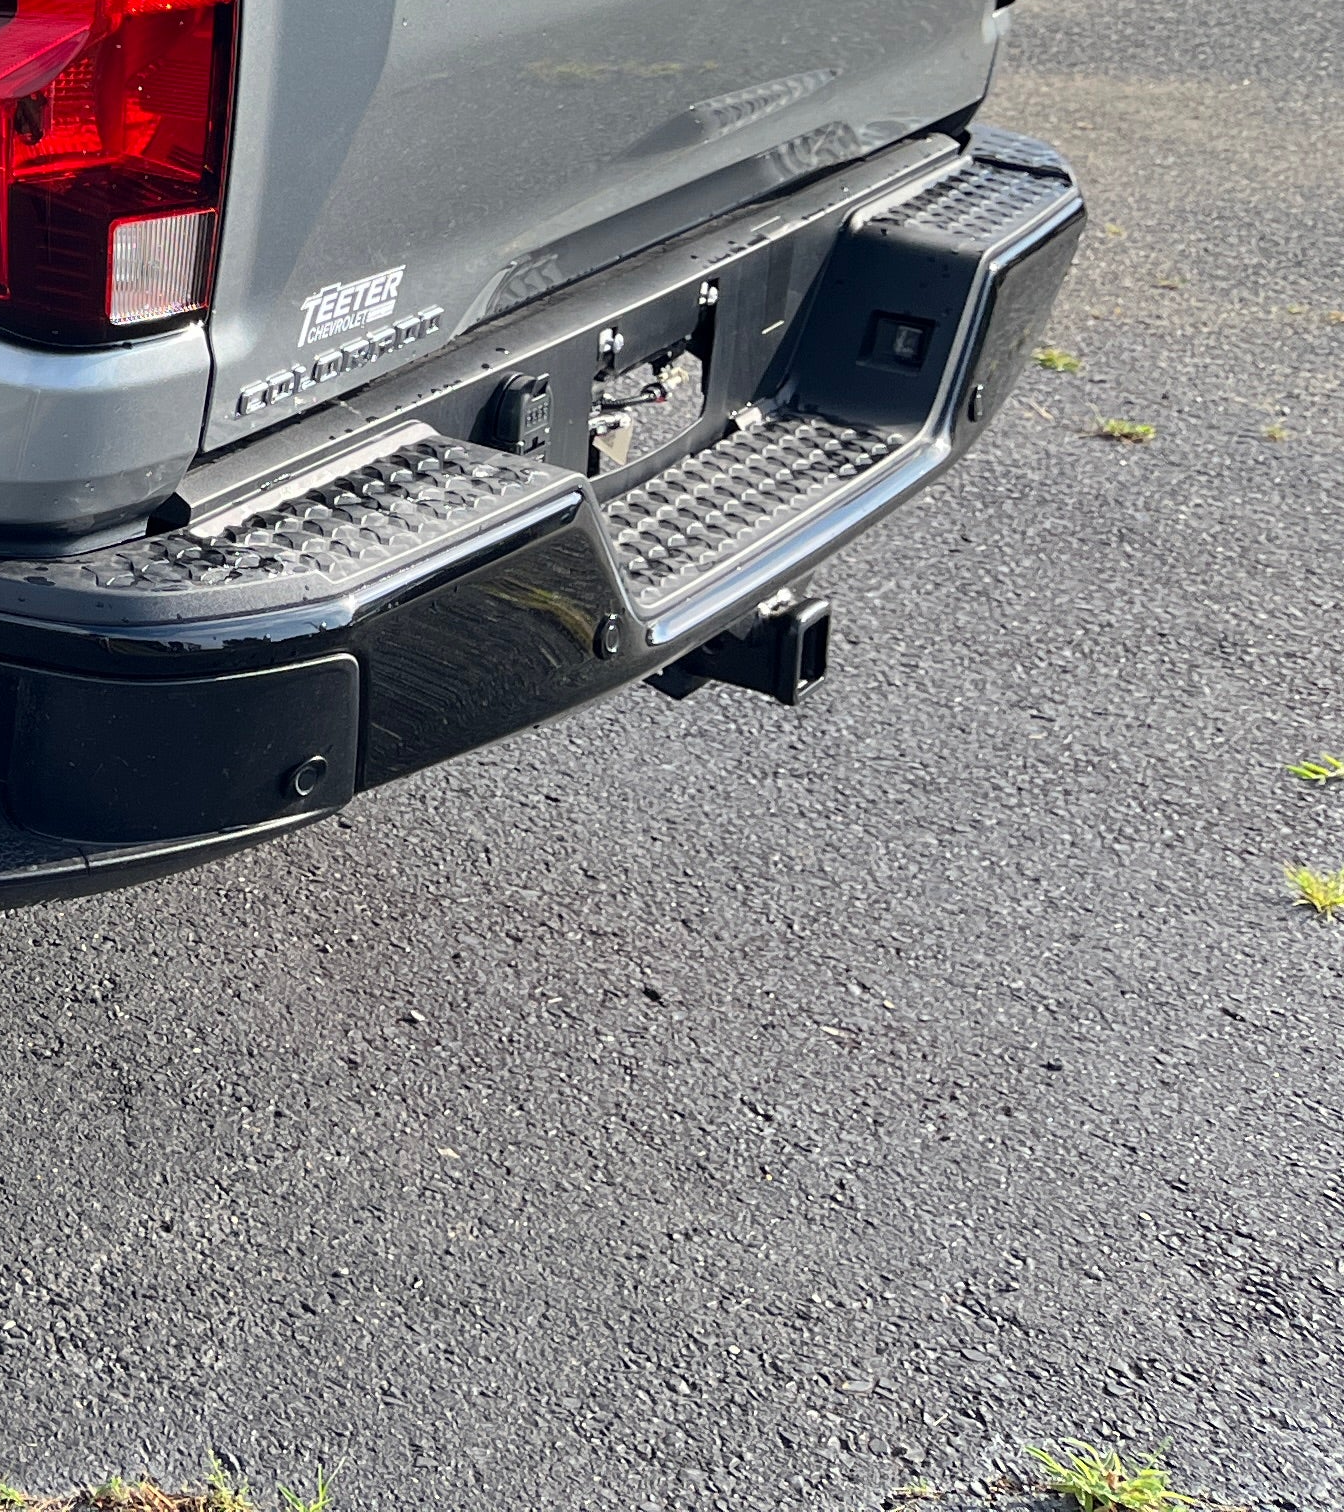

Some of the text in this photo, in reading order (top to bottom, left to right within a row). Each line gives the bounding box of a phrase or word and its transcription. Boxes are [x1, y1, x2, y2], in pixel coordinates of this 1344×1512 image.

[297, 264, 406, 348] TEETER
[307, 309, 370, 344] CHEVROLET
[234, 304, 445, 419] COLORADO
